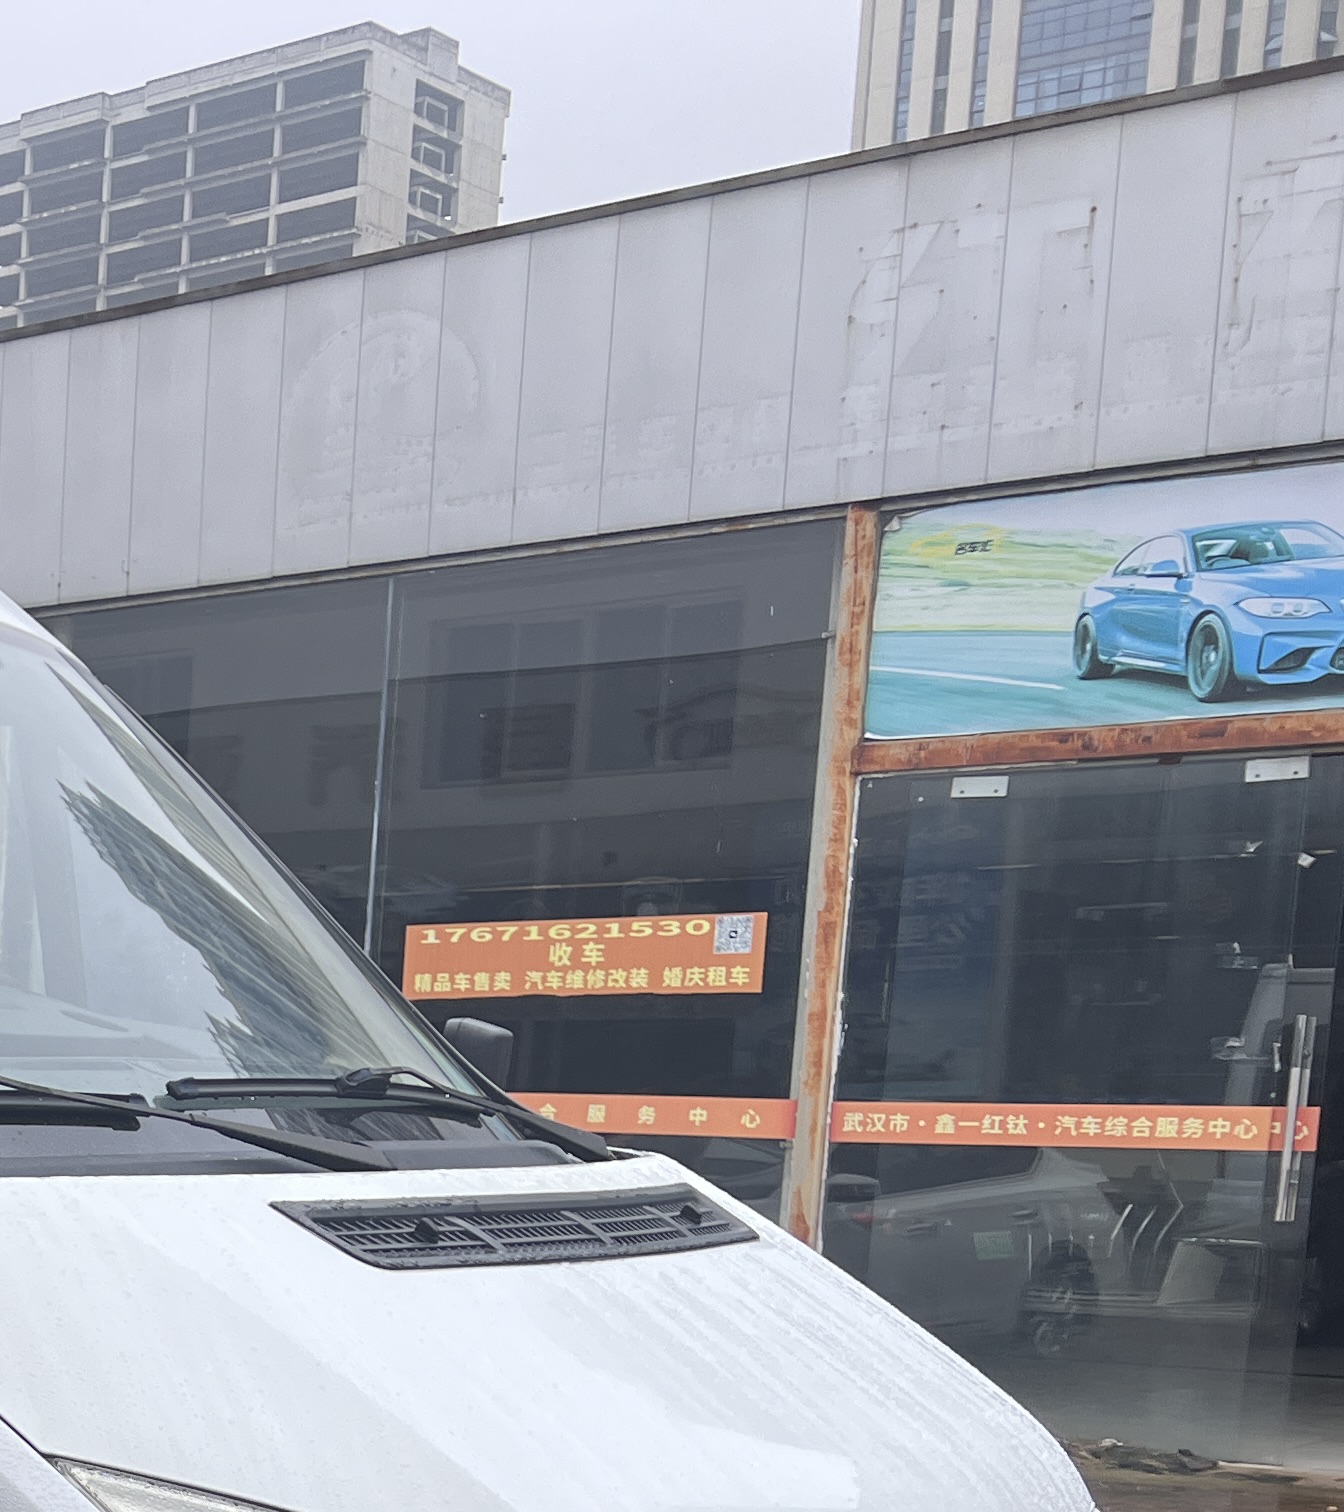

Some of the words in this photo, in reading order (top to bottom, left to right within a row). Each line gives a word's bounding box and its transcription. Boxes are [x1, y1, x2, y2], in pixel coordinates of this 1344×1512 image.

[420, 919, 711, 944] 17671621530
[414, 971, 511, 993] 精品车售卖
[524, 967, 650, 990] 汽车维修改装
[662, 965, 750, 987] 婚庆租车
